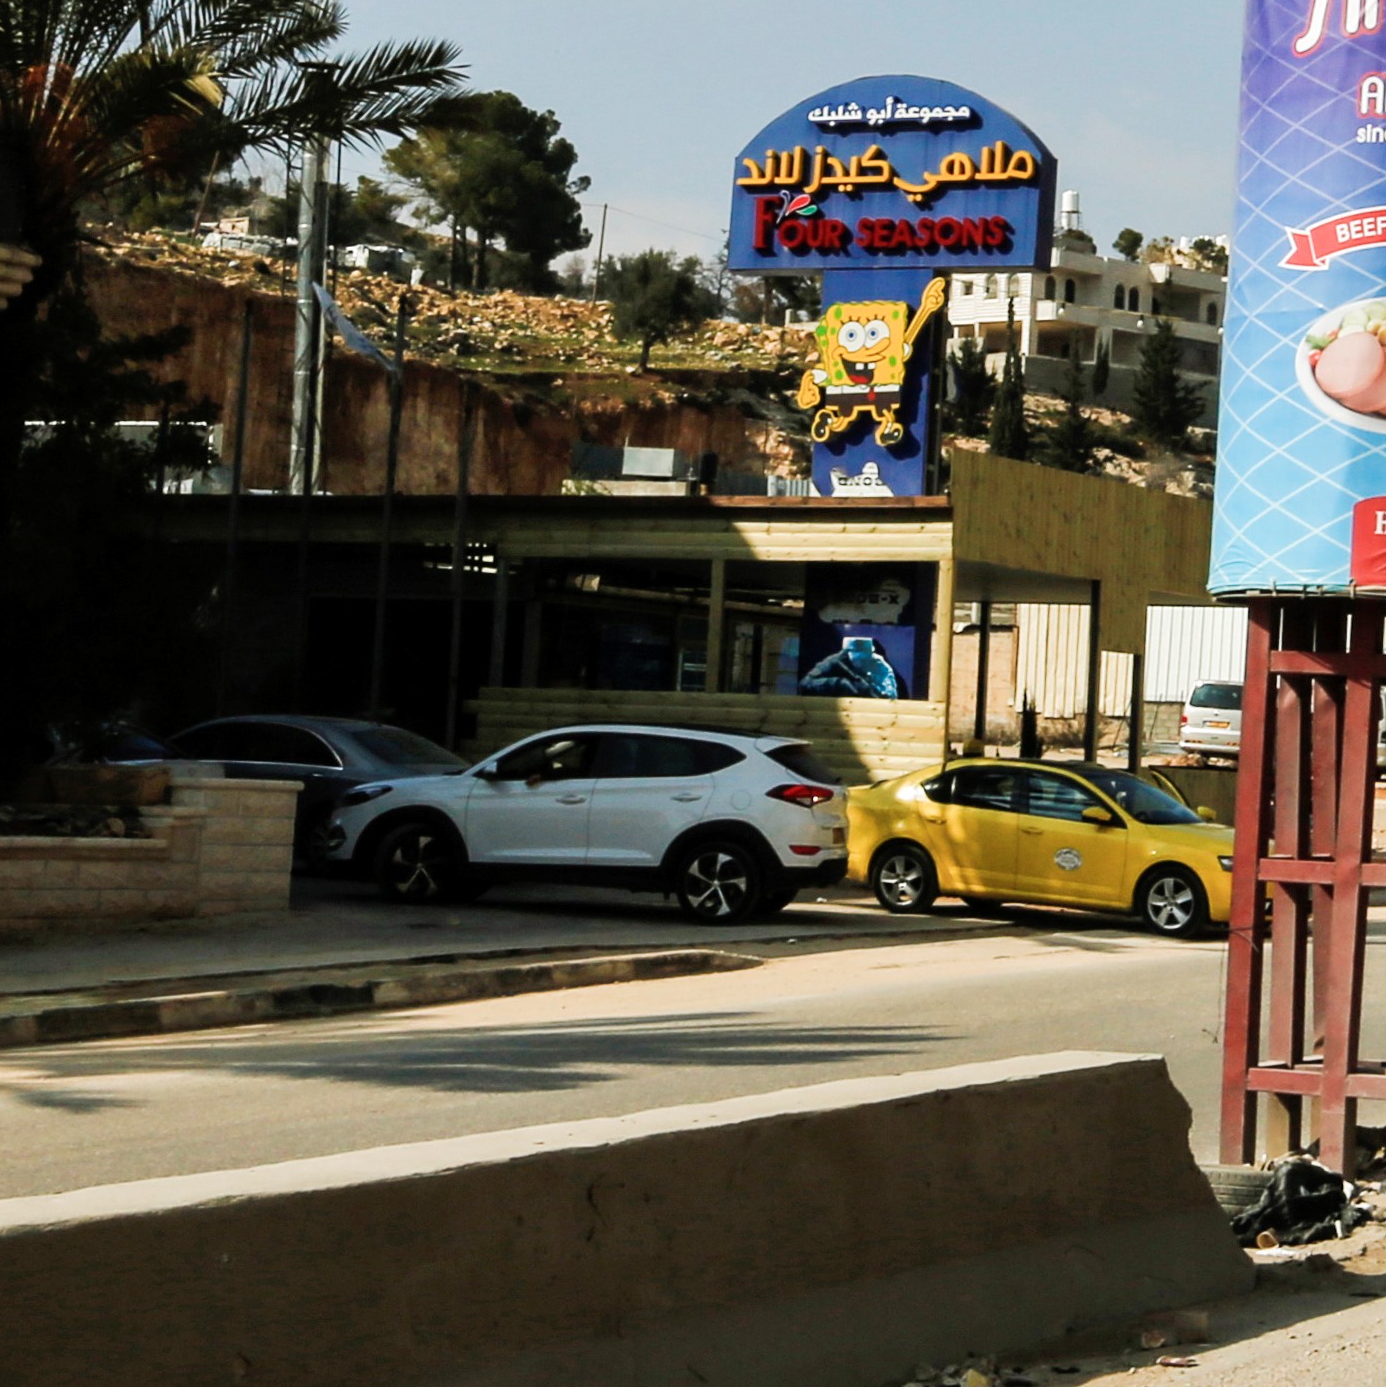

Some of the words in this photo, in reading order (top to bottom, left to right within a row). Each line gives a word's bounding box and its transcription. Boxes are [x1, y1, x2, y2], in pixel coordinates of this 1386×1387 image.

[866, 95, 894, 125] أبو
[894, 103, 971, 123] مجموعة
[893, 140, 1034, 202] ملاهي
[856, 215, 1006, 247] SEASONS
